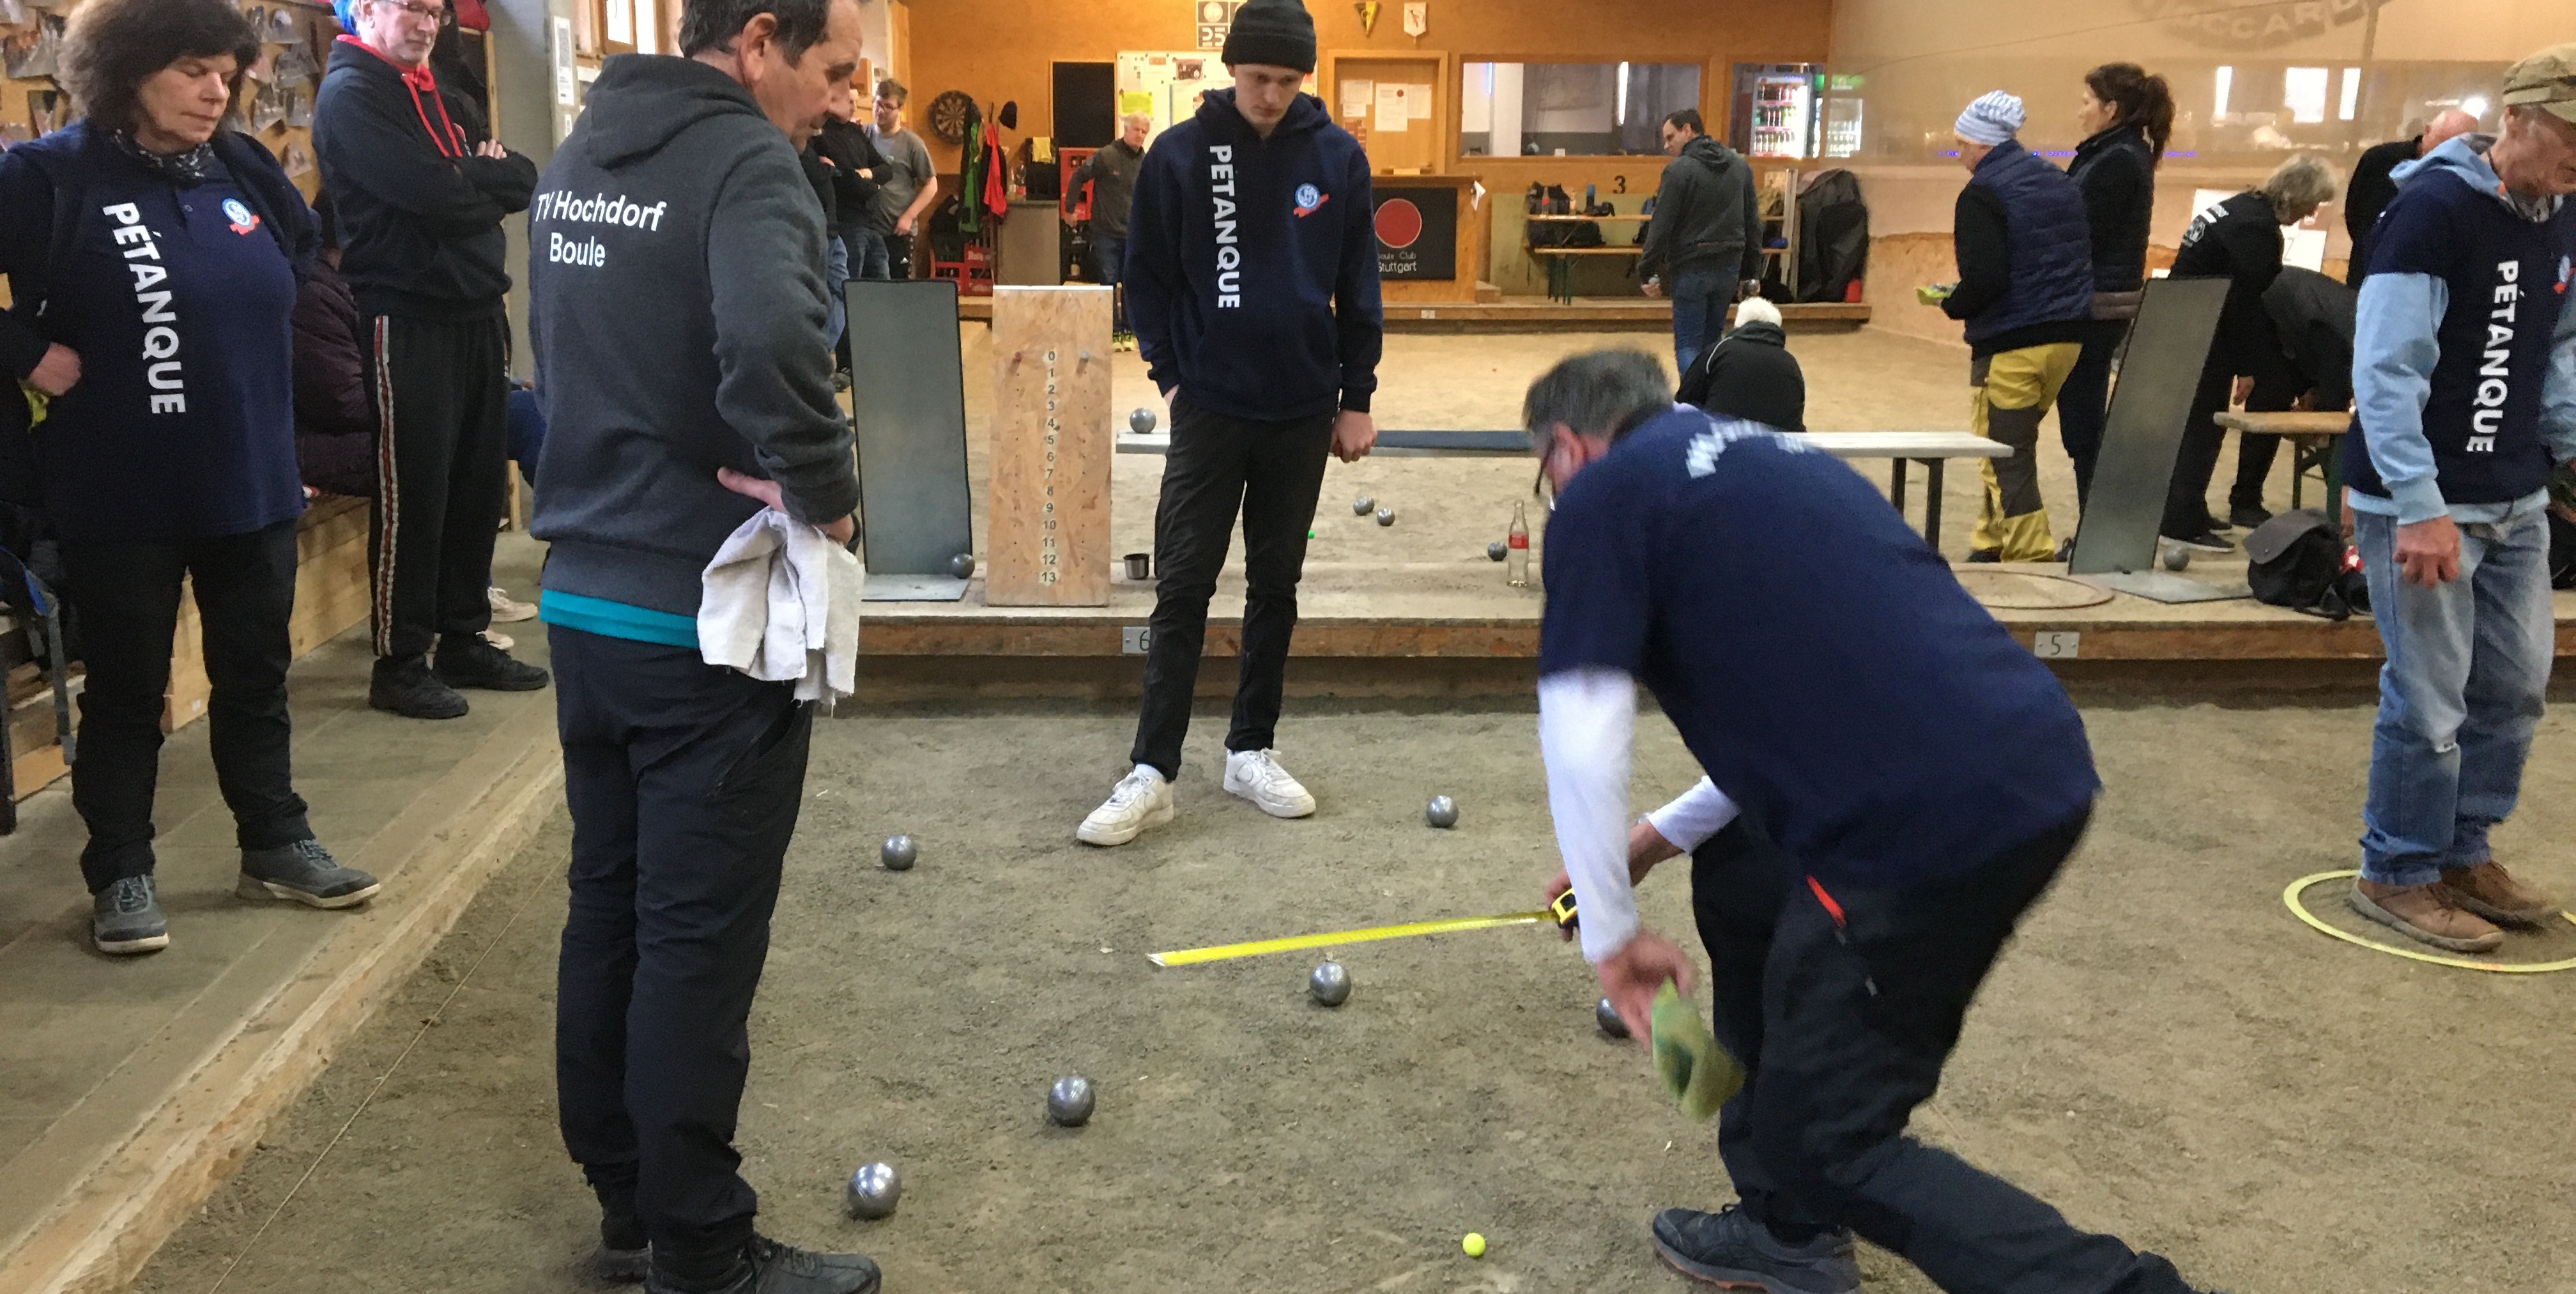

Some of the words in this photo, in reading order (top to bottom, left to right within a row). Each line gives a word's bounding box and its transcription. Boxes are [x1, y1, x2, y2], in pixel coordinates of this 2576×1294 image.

[1202, 27, 1226, 47] 25
[1613, 175, 1626, 194] 3
[535, 191, 555, 222] TV
[553, 190, 668, 232] Hochdorf
[549, 231, 606, 268] Boule
[1399, 250, 1417, 260] Club
[102, 202, 187, 414] PÉTANQUE
[1048, 351, 1055, 361] 0
[2466, 259, 2526, 453] PÉTANQUE
[1047, 367, 1054, 378] 1
[1048, 384, 1055, 394] 2
[1048, 400, 1055, 411] 3
[1047, 417, 1055, 428] 4
[1047, 435, 1055, 445] 5
[1046, 451, 1055, 462] 6
[1046, 468, 1054, 479] 7
[1046, 486, 1054, 496] 8
[1046, 502, 1054, 512] 9
[1043, 520, 1057, 530] 10
[1042, 537, 1055, 548] 11
[1042, 553, 1056, 565] 12
[1041, 571, 1056, 583] 13
[1139, 630, 1149, 651] 6
[2051, 635, 2061, 655] 5
